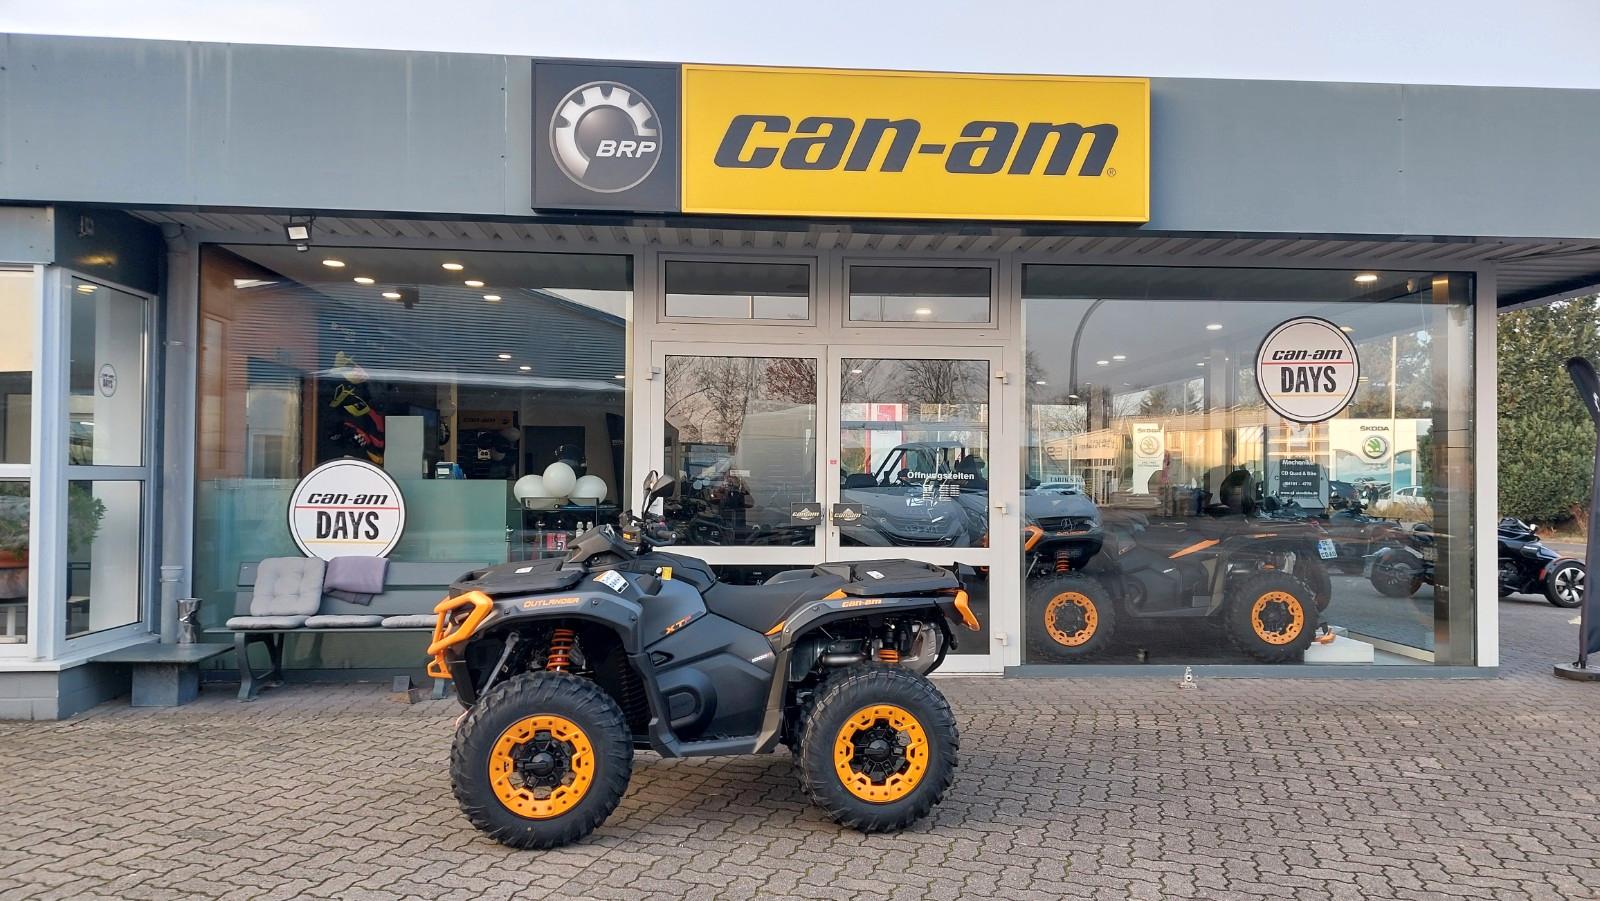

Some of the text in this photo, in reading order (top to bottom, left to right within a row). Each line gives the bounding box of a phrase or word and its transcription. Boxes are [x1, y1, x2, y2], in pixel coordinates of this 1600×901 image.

[596, 139, 657, 158] BRP
[713, 114, 1119, 177] can-am
[1271, 349, 1343, 361] can-am
[1280, 365, 1337, 393] DAYS
[307, 493, 389, 505] can-am
[316, 510, 379, 540] DAYS
[523, 597, 580, 609] OUTLANDER
